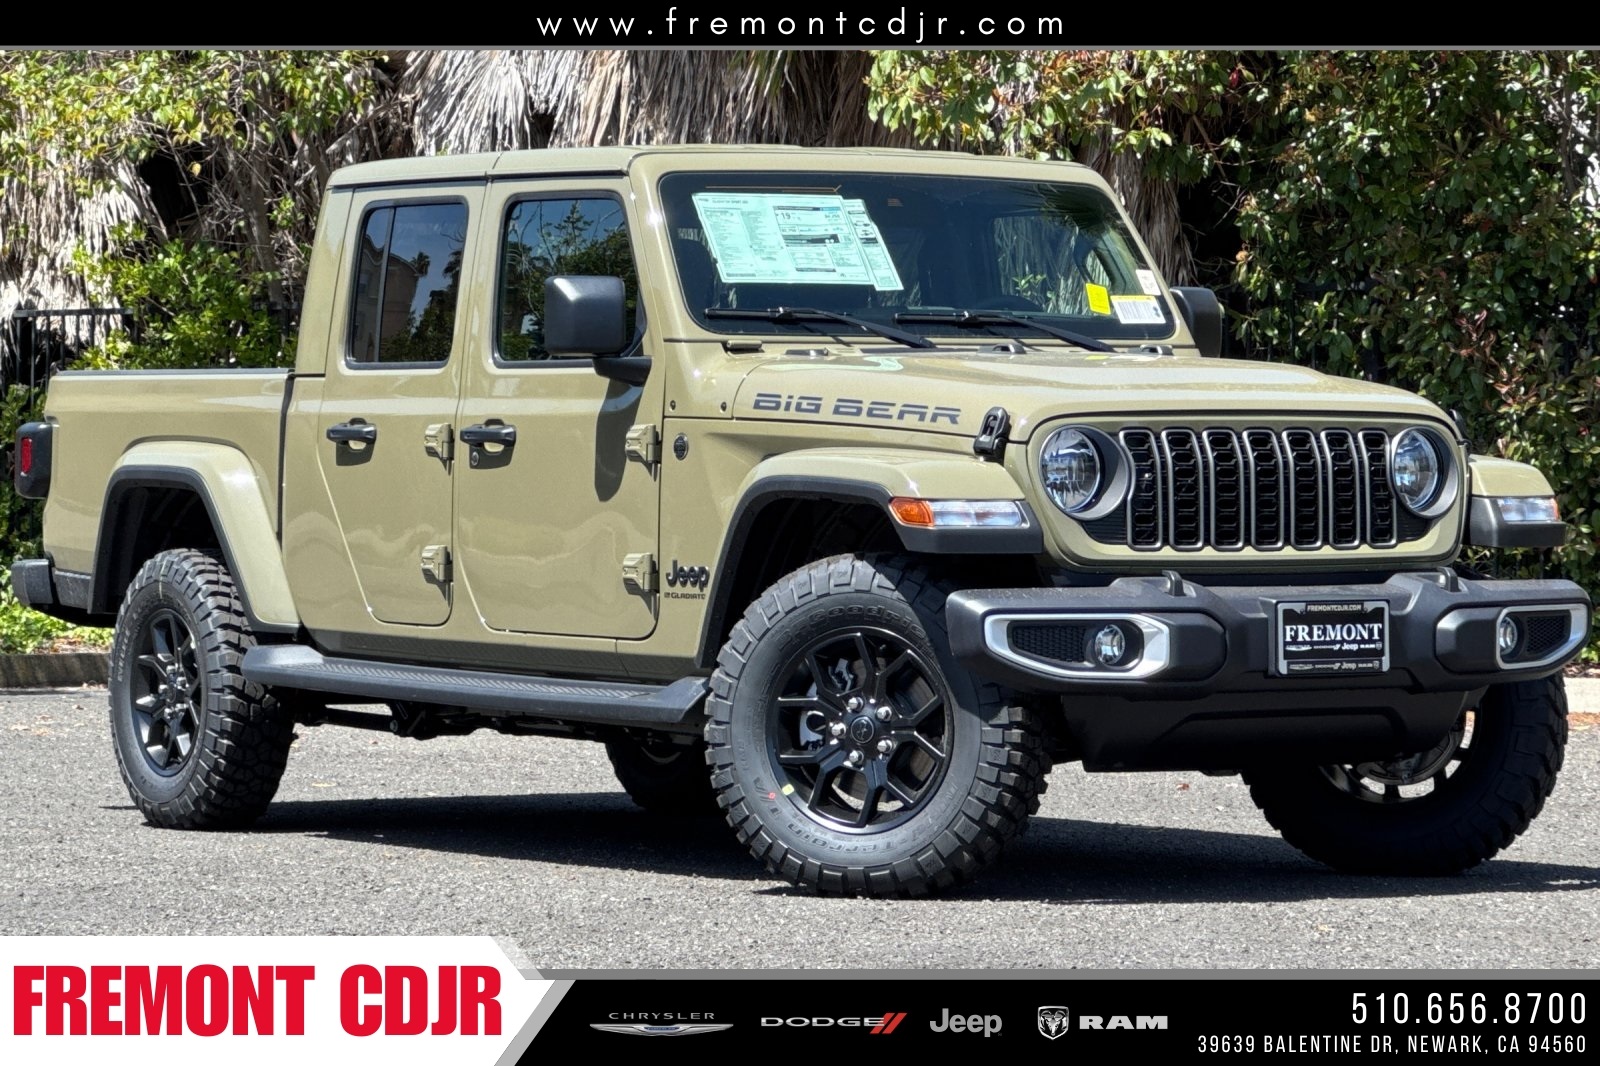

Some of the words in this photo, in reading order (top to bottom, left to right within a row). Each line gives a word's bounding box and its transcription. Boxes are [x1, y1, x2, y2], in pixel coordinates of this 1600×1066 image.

[832, 398, 962, 425] BEAR
[666, 560, 710, 592] Jeep
[1285, 624, 1382, 641] FREMONT
